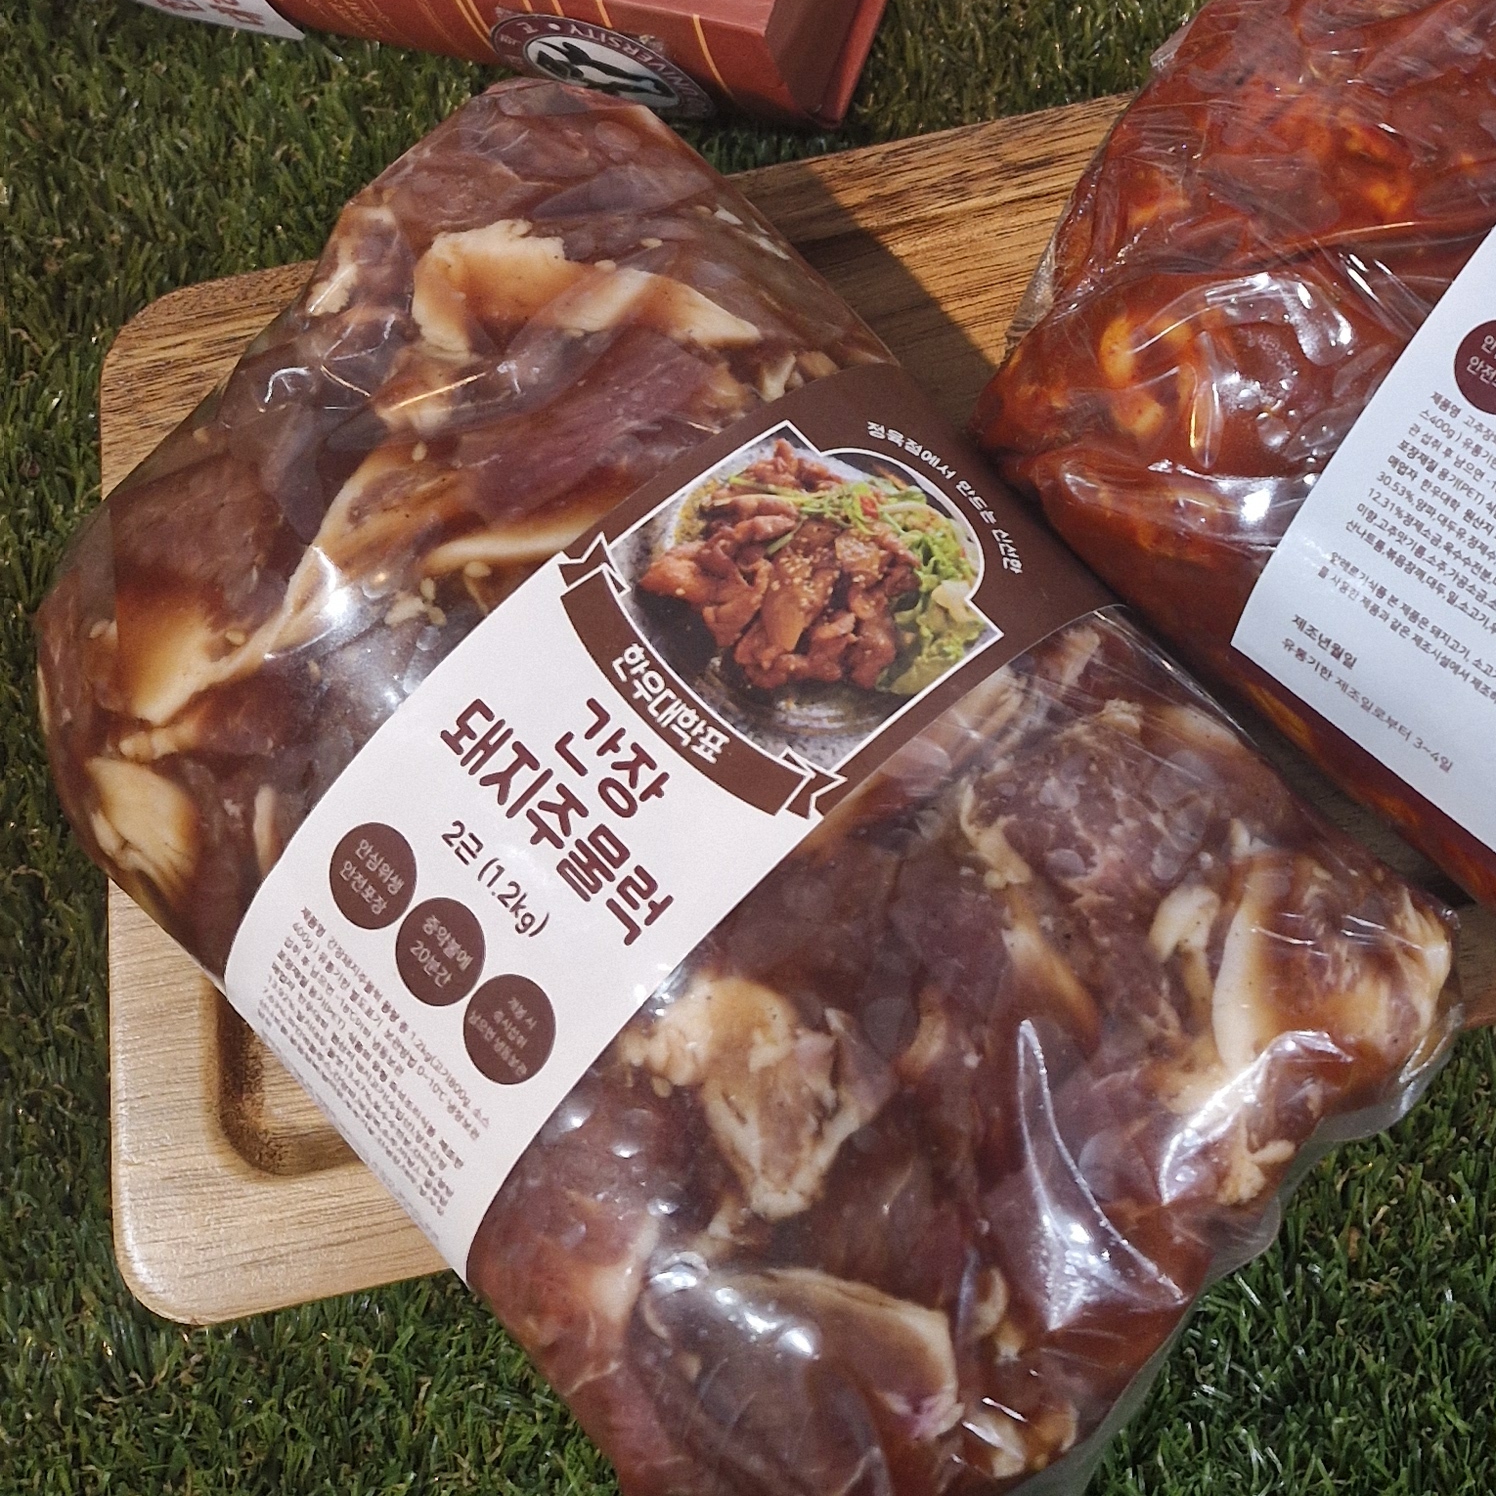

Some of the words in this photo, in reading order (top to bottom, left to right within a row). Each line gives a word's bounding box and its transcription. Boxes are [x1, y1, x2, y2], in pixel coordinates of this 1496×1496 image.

[1419, 410, 1455, 439] 스400g
[1431, 392, 1461, 418] 제품명
[1398, 440, 1438, 473] 포장재질
[1438, 468, 1484, 505] 용기(PET)
[1421, 433, 1442, 451] 섭취
[1454, 455, 1485, 482] 남으면
[867, 420, 957, 480] 정육점에서
[955, 480, 997, 525] 만드는
[991, 528, 1023, 574] 신선한
[1292, 615, 1357, 670] 제조년월일
[611, 641, 733, 764] 한우대학표
[1283, 639, 1332, 681] 유통기한
[1335, 678, 1412, 741] 제조일로부터
[1413, 737, 1453, 773] 3~4일
[555, 698, 669, 818] 간장
[440, 699, 674, 946] 돼지주물럭
[340, 861, 387, 914] 안전포장
[355, 839, 404, 895] 안심위생
[442, 821, 483, 865] 2근
[478, 858, 549, 937] (1.2kg)
[410, 940, 452, 987] 20분간
